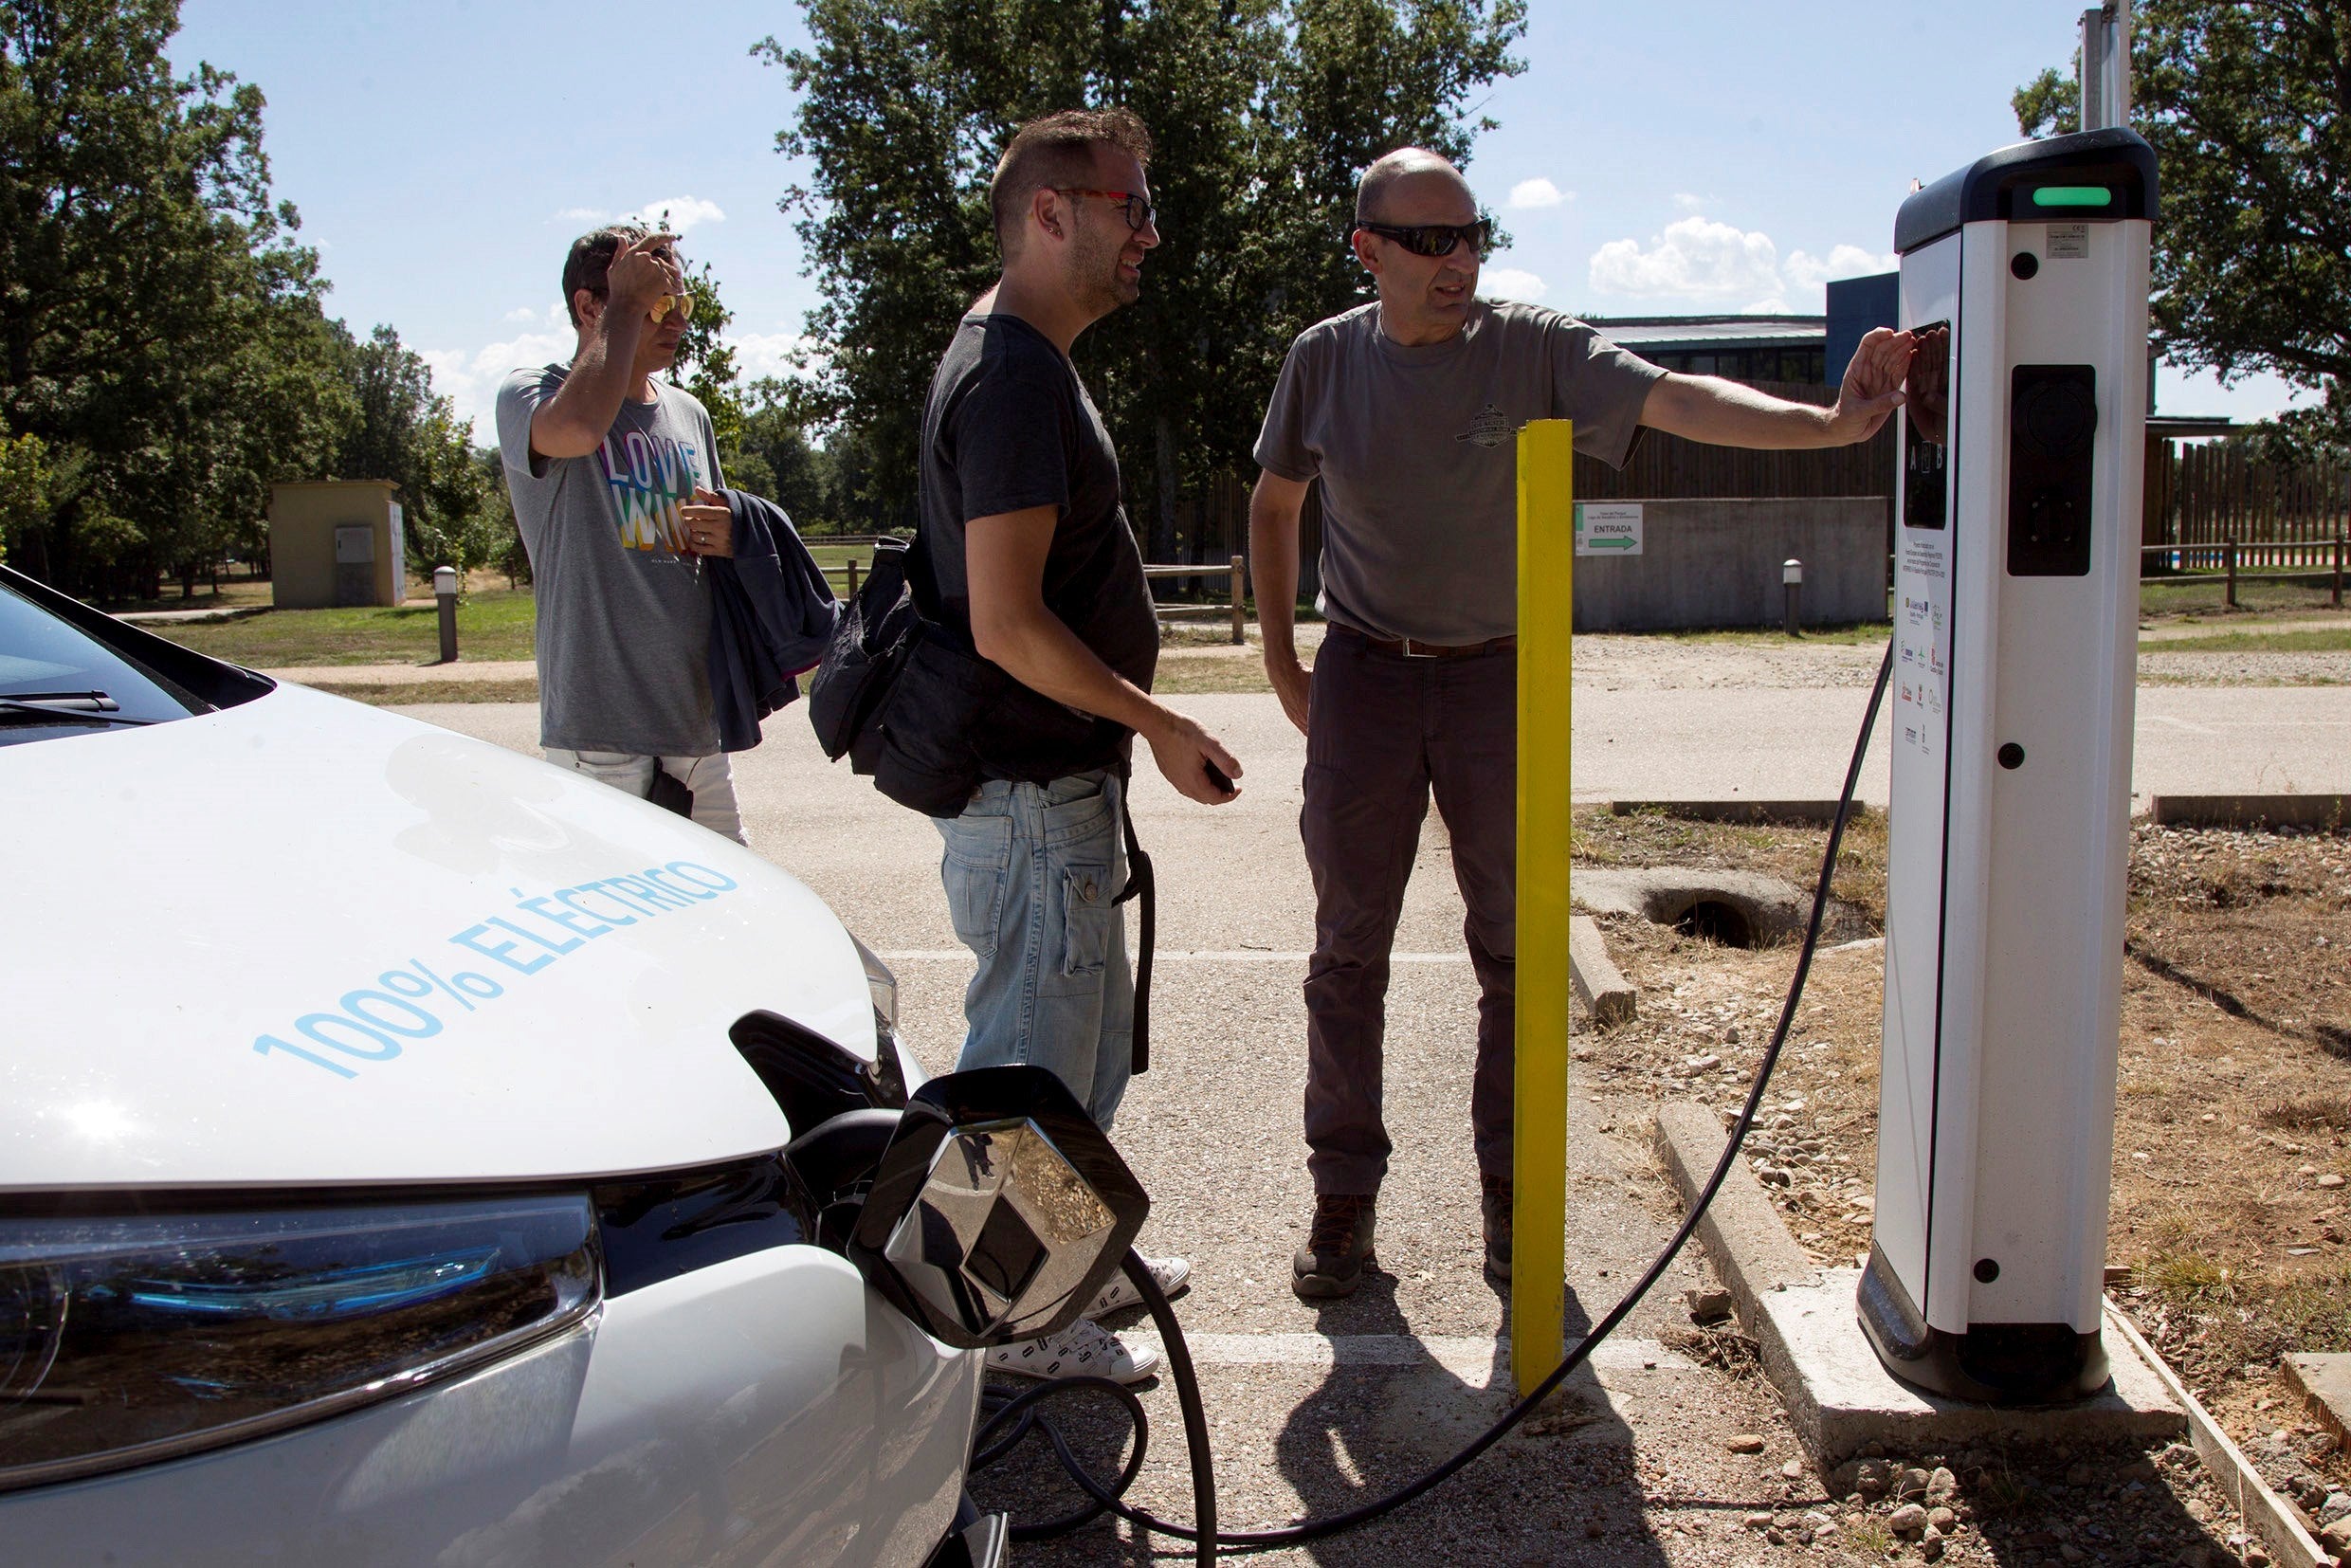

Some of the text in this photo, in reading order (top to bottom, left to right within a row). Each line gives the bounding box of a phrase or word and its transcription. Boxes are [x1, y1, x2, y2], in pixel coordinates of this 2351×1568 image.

[599, 431, 701, 499] LOVE
[1909, 444, 1943, 470] A B
[610, 483, 705, 556] WIN
[1594, 525, 1632, 534] ENTRADA
[252, 860, 739, 1080] 100% ELÉCTRICO
